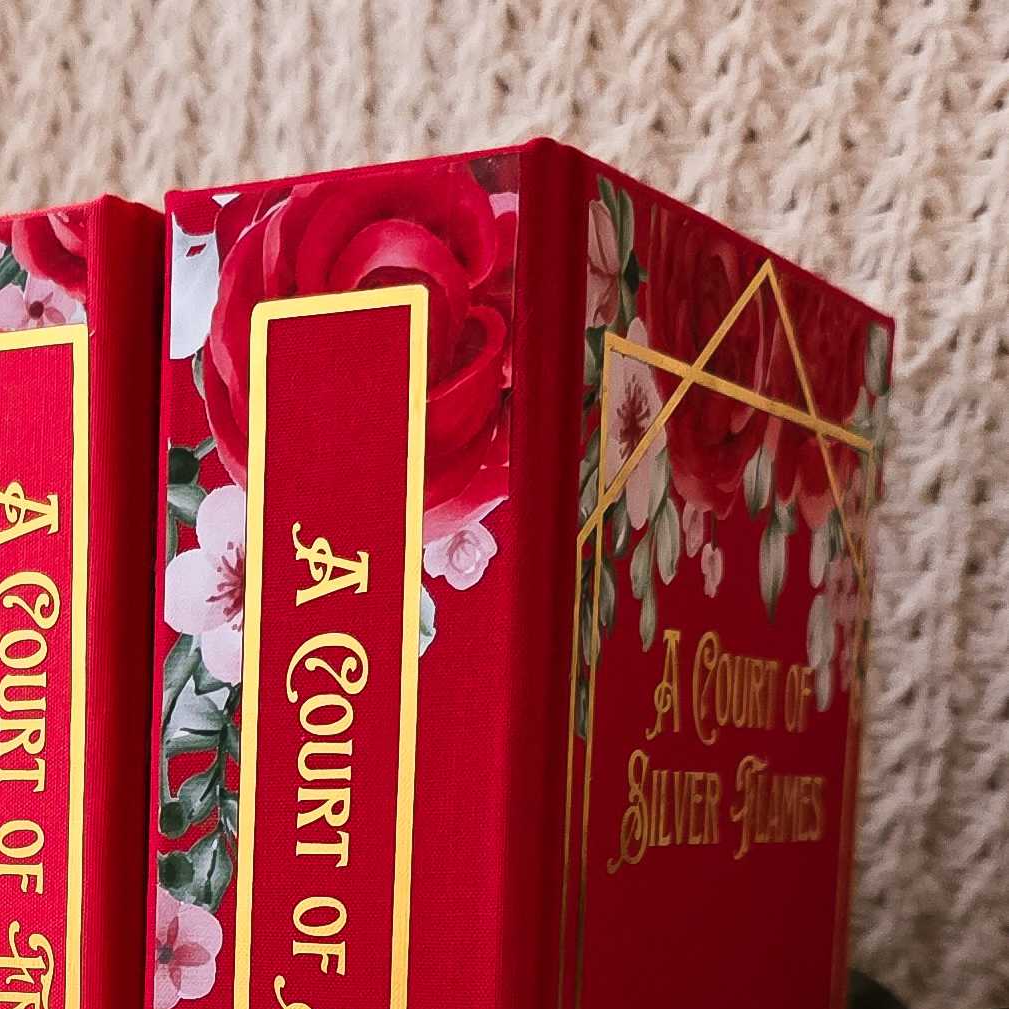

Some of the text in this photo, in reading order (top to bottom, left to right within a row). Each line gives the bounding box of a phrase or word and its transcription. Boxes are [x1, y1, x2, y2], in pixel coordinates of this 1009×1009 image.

[292, 521, 370, 607] A
[645, 629, 815, 745] A COURT OF
[286, 632, 369, 869] COURT
[607, 749, 826, 874] SILVER FLAMES
[292, 896, 348, 976] OF
